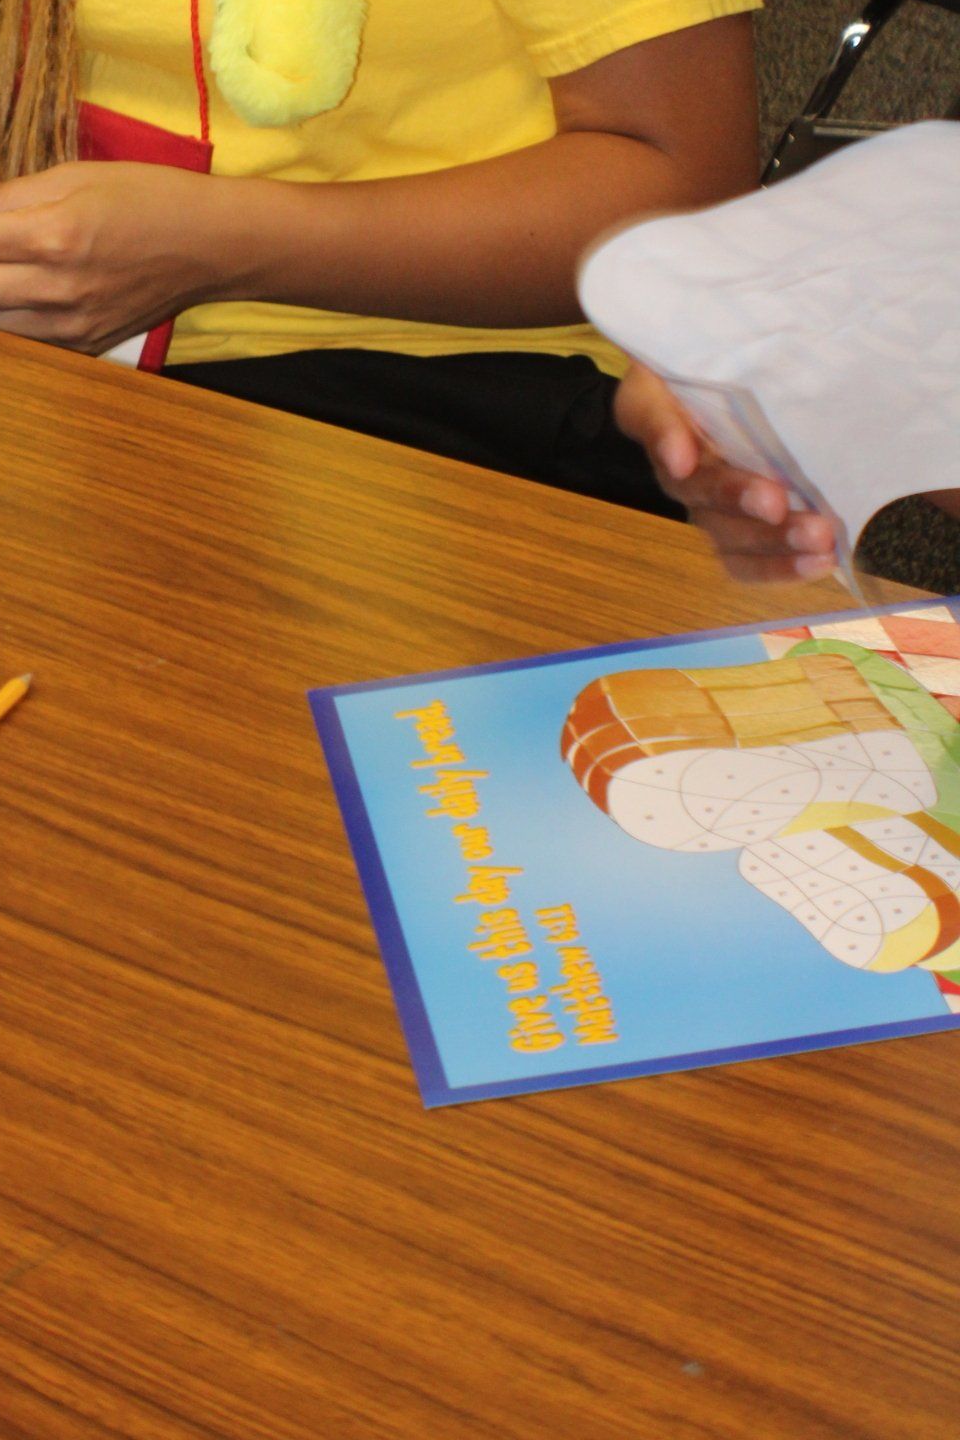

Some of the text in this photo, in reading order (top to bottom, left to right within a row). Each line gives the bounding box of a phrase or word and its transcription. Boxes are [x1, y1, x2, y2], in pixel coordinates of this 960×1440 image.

[419, 769, 488, 819] daily
[452, 823, 494, 860] our
[454, 866, 523, 905] day
[468, 908, 532, 958] this
[498, 962, 538, 992] us
[535, 904, 617, 1044] Matthew 6:11
[509, 996, 565, 1051] Give
